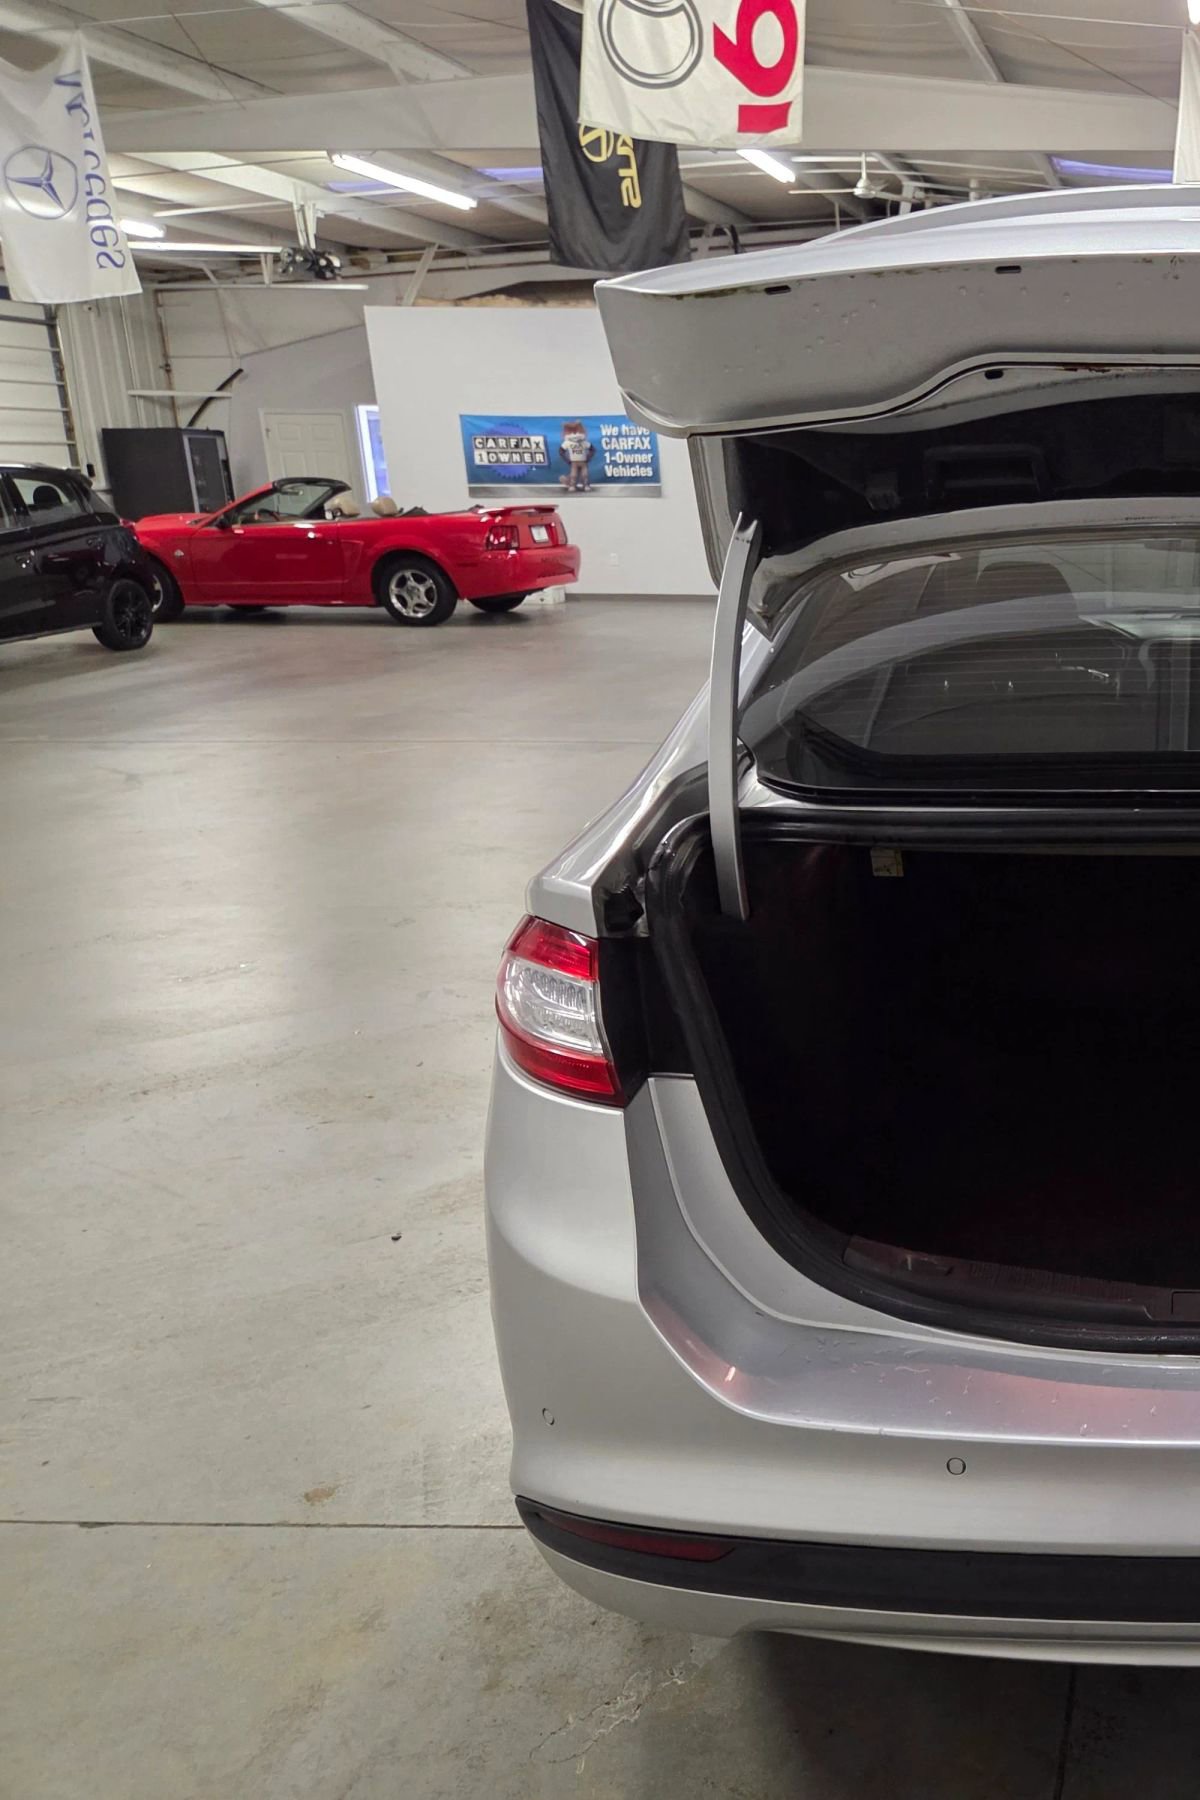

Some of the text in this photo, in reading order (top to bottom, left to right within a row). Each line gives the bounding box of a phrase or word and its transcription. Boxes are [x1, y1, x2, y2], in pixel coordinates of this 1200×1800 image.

[600, 424, 618, 436] We
[474, 438, 542, 449] CARFAX
[602, 437, 651, 450] CARFAX
[604, 451, 653, 463] 1-Owner
[604, 465, 653, 477] Vehicles
